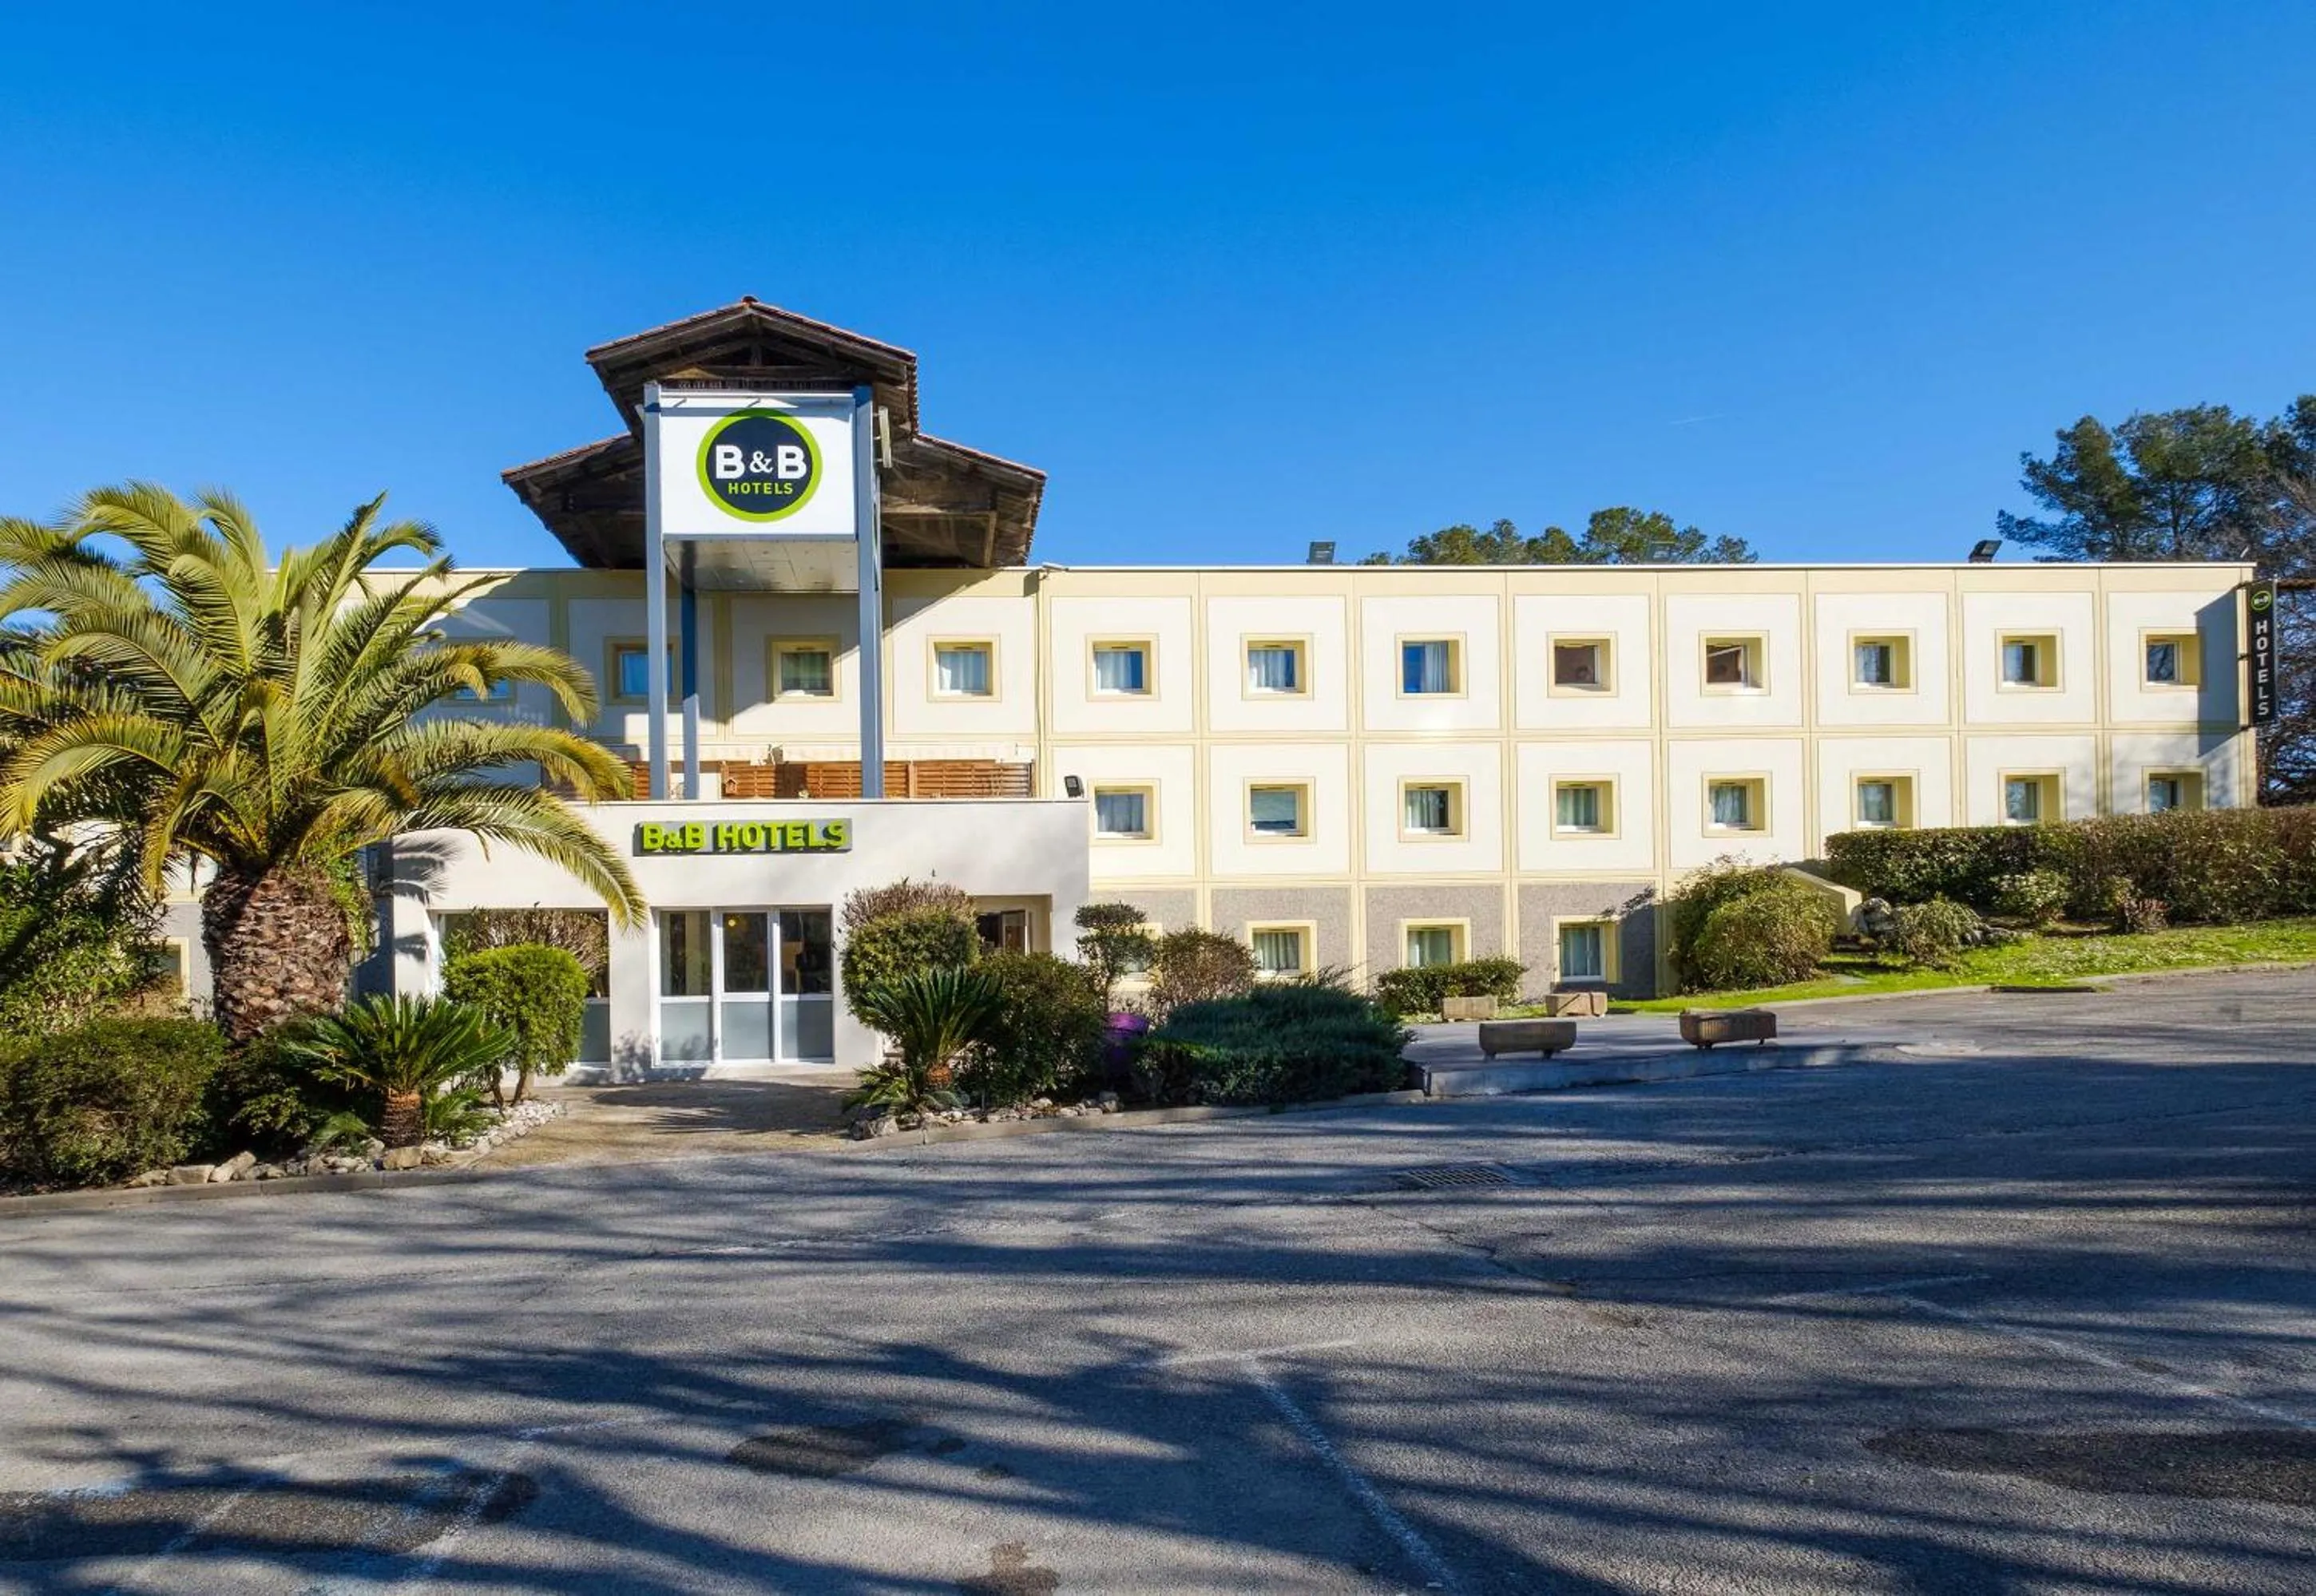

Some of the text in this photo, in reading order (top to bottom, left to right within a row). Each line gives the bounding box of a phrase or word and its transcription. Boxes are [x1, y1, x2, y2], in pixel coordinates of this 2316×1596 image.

[716, 445, 807, 479] B&B
[728, 482, 793, 494] HOTELS
[2255, 620, 2269, 715] HOTELS
[642, 819, 848, 849] B&B HOTELS
